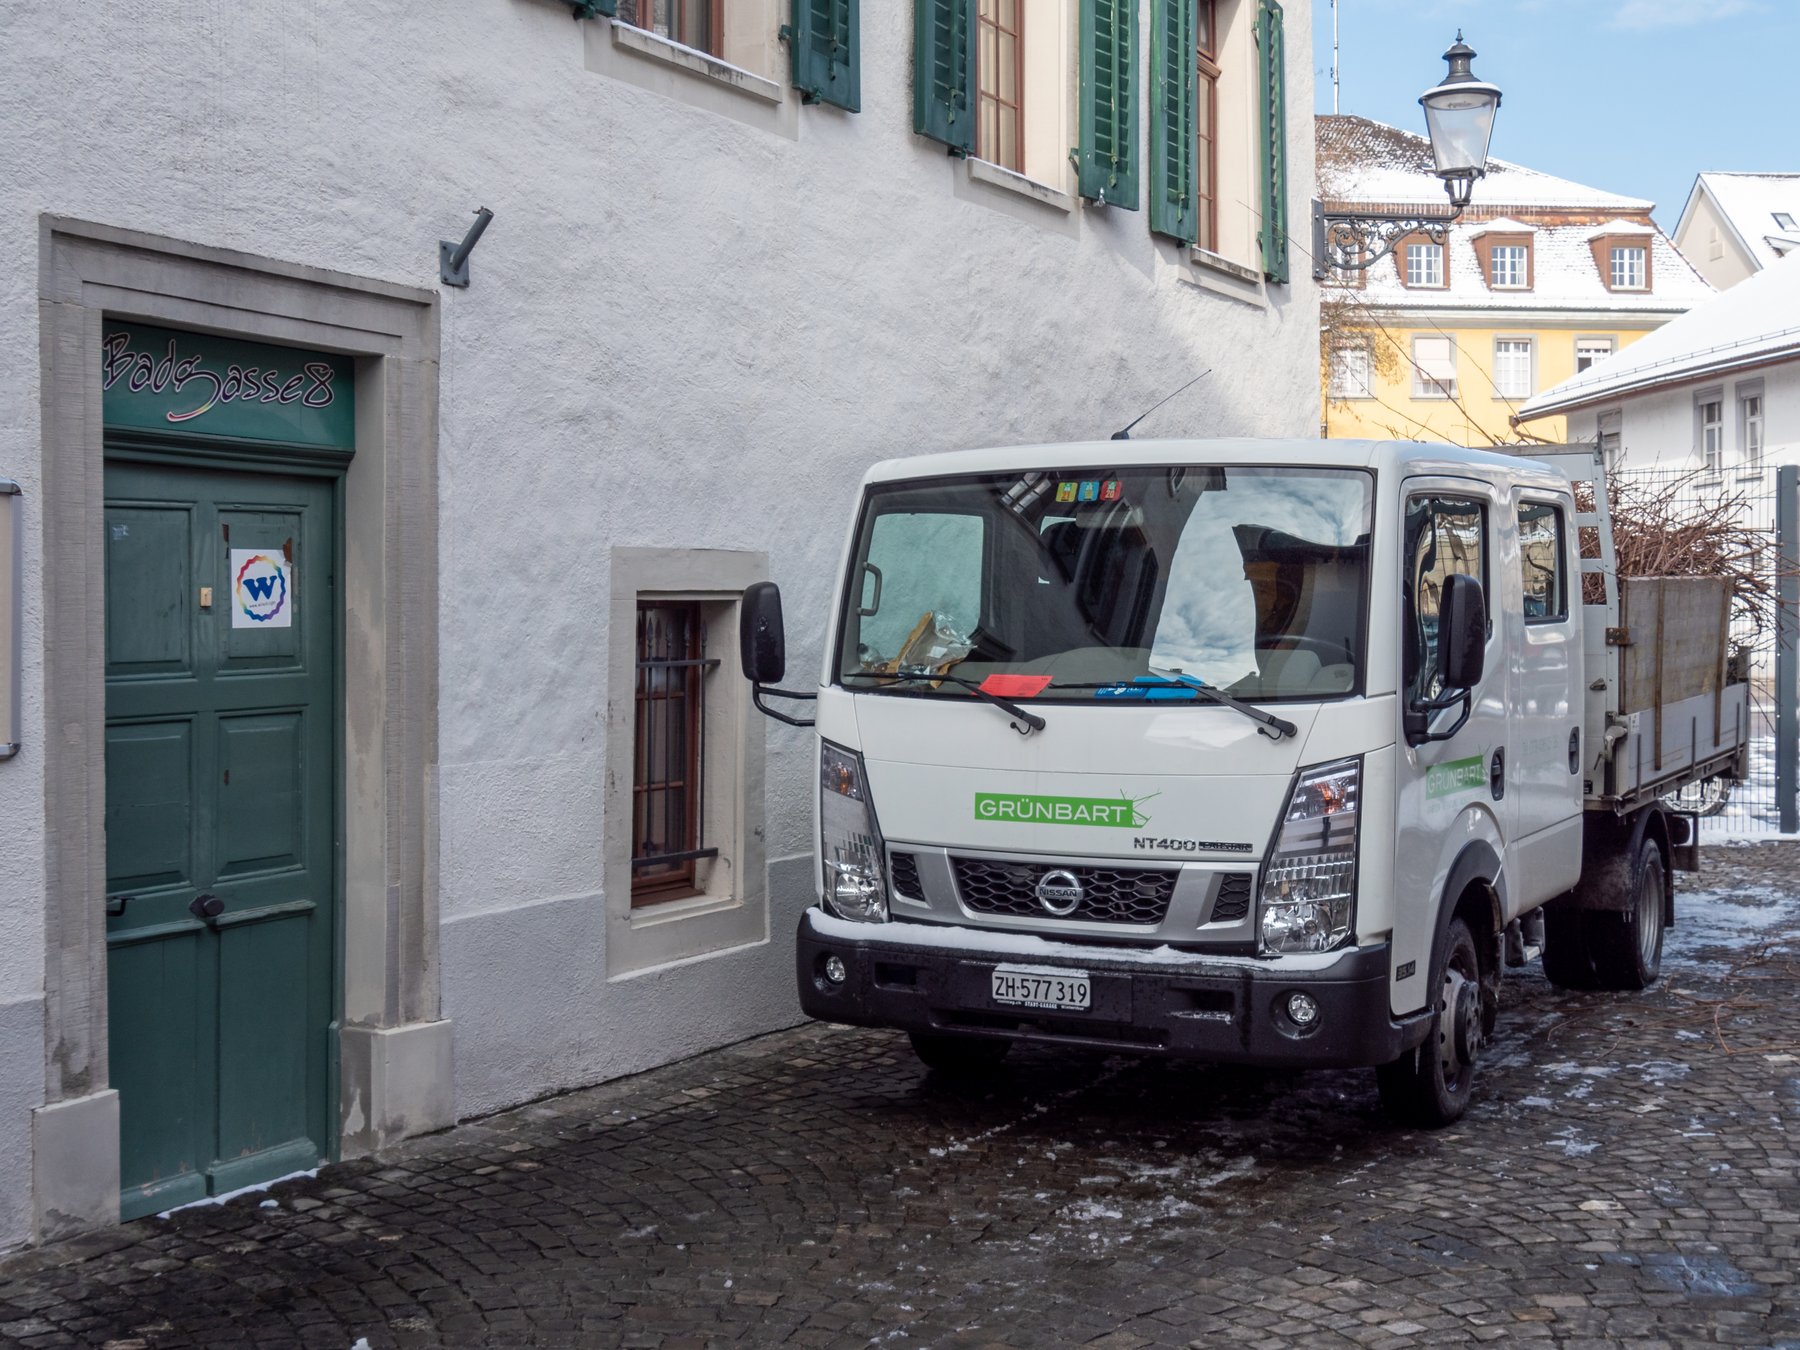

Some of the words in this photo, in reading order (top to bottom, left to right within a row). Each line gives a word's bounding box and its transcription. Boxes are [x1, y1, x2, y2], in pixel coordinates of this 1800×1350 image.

[243, 575, 277, 602] W
[979, 798, 1127, 823] GRÜNBART
[1134, 836, 1196, 852] NT400
[1039, 888, 1078, 898] NISSAN
